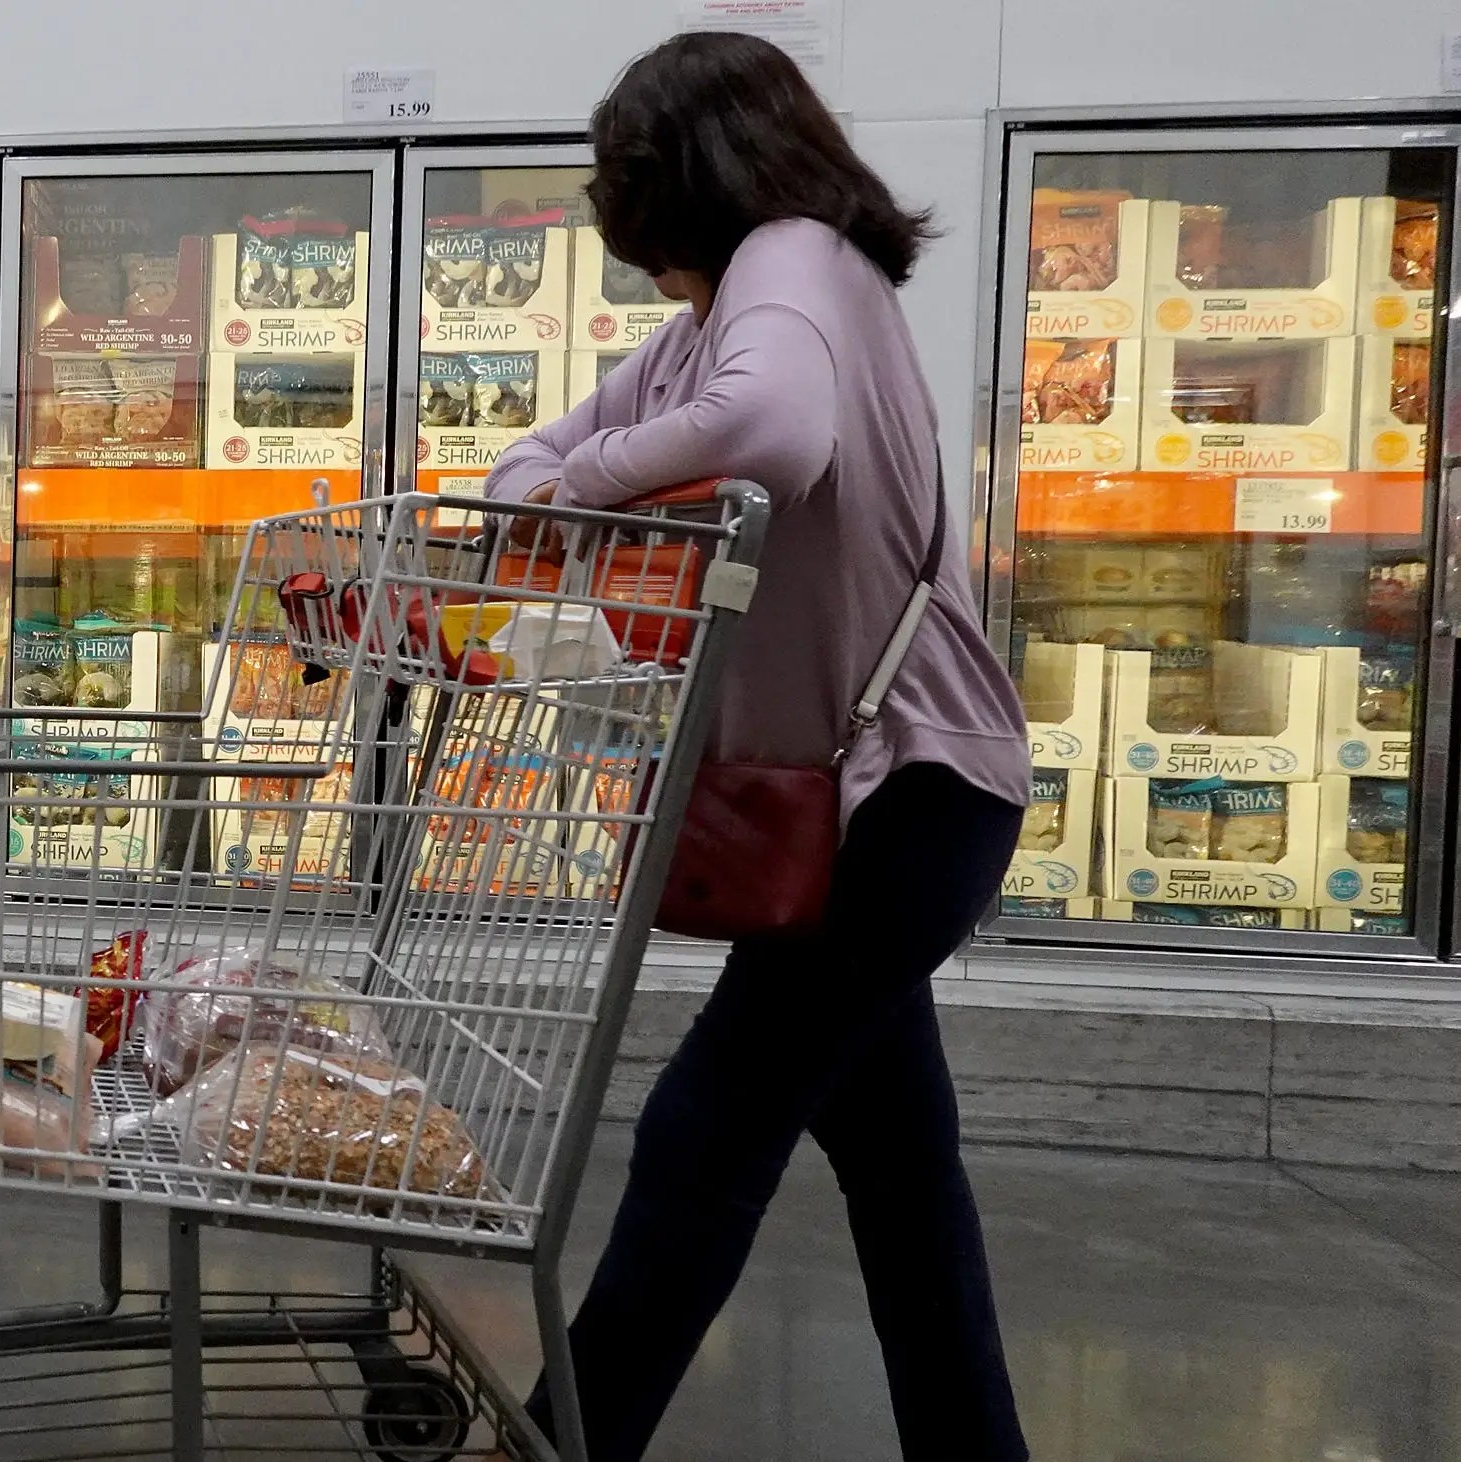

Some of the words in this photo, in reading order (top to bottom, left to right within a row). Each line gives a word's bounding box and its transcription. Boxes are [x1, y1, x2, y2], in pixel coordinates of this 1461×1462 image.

[390, 102, 430, 117] 15.99
[293, 243, 354, 262] SHRIM
[1029, 315, 1089, 334] RIMP
[1200, 315, 1297, 333] SHRIMP
[80, 334, 104, 342] WILD
[105, 333, 154, 342] ARGENTINE
[161, 334, 192, 345] 30-50
[258, 331, 336, 347] SHRIMP
[436, 324, 517, 341] SHRIMP
[478, 358, 534, 376] SHRIM
[75, 451, 98, 459] WILD
[99, 451, 148, 459] ARGENTINE
[155, 452, 186, 462] 30-50
[257, 449, 335, 464] SHRIMP
[438, 448, 500, 465] SHRIM
[1022, 447, 1082, 465] RIMP
[1198, 450, 1295, 469] SHRIMP
[1282, 515, 1327, 529] 13.99
[14, 644, 64, 660] SHRIM
[77, 641, 130, 657] SHRIM
[1167, 756, 1259, 774] SHRIMP
[1221, 792, 1282, 810] HRIM
[257, 858, 330, 873] SHIMP
[1166, 882, 1258, 900] SHRIMP
